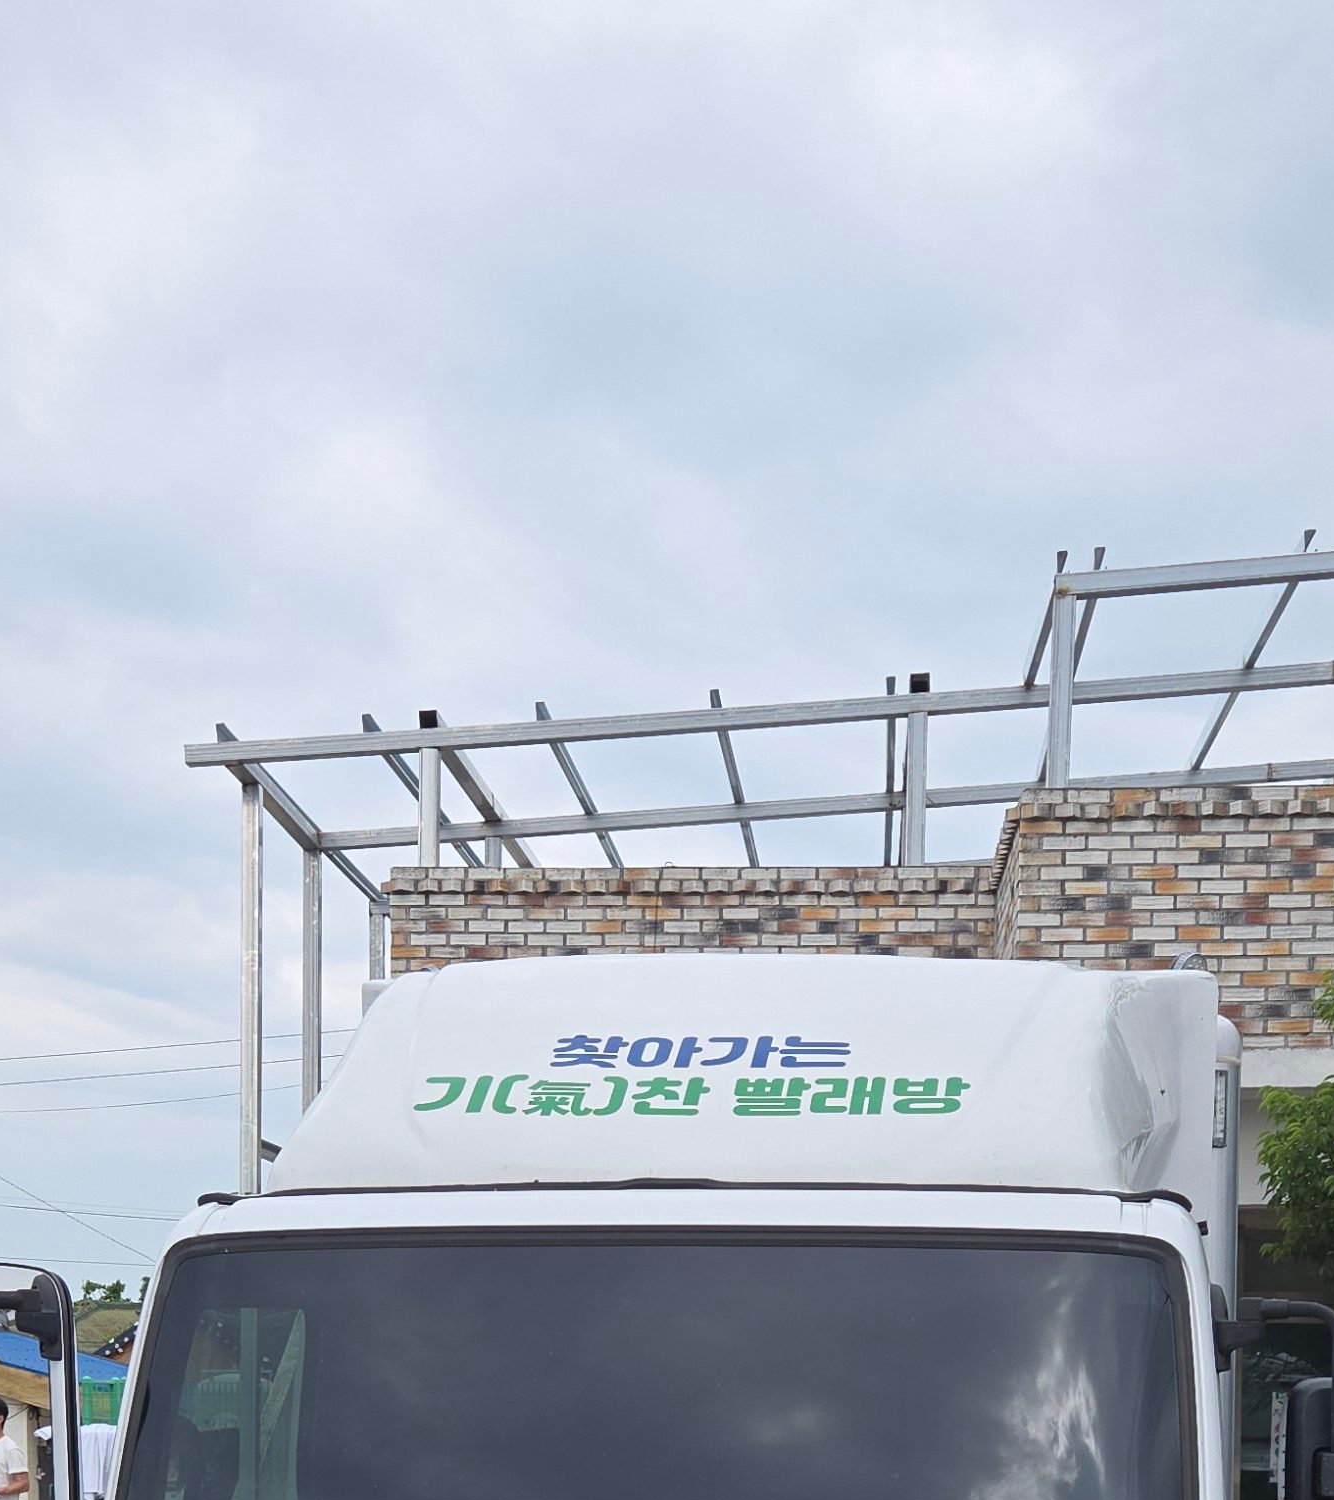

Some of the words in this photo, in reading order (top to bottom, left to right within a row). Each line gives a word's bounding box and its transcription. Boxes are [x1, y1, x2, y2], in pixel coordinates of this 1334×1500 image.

[550, 1034, 852, 1069] 찾아가는
[413, 1074, 711, 1116] 기(氣)찬
[732, 1076, 971, 1117] 빨래방
